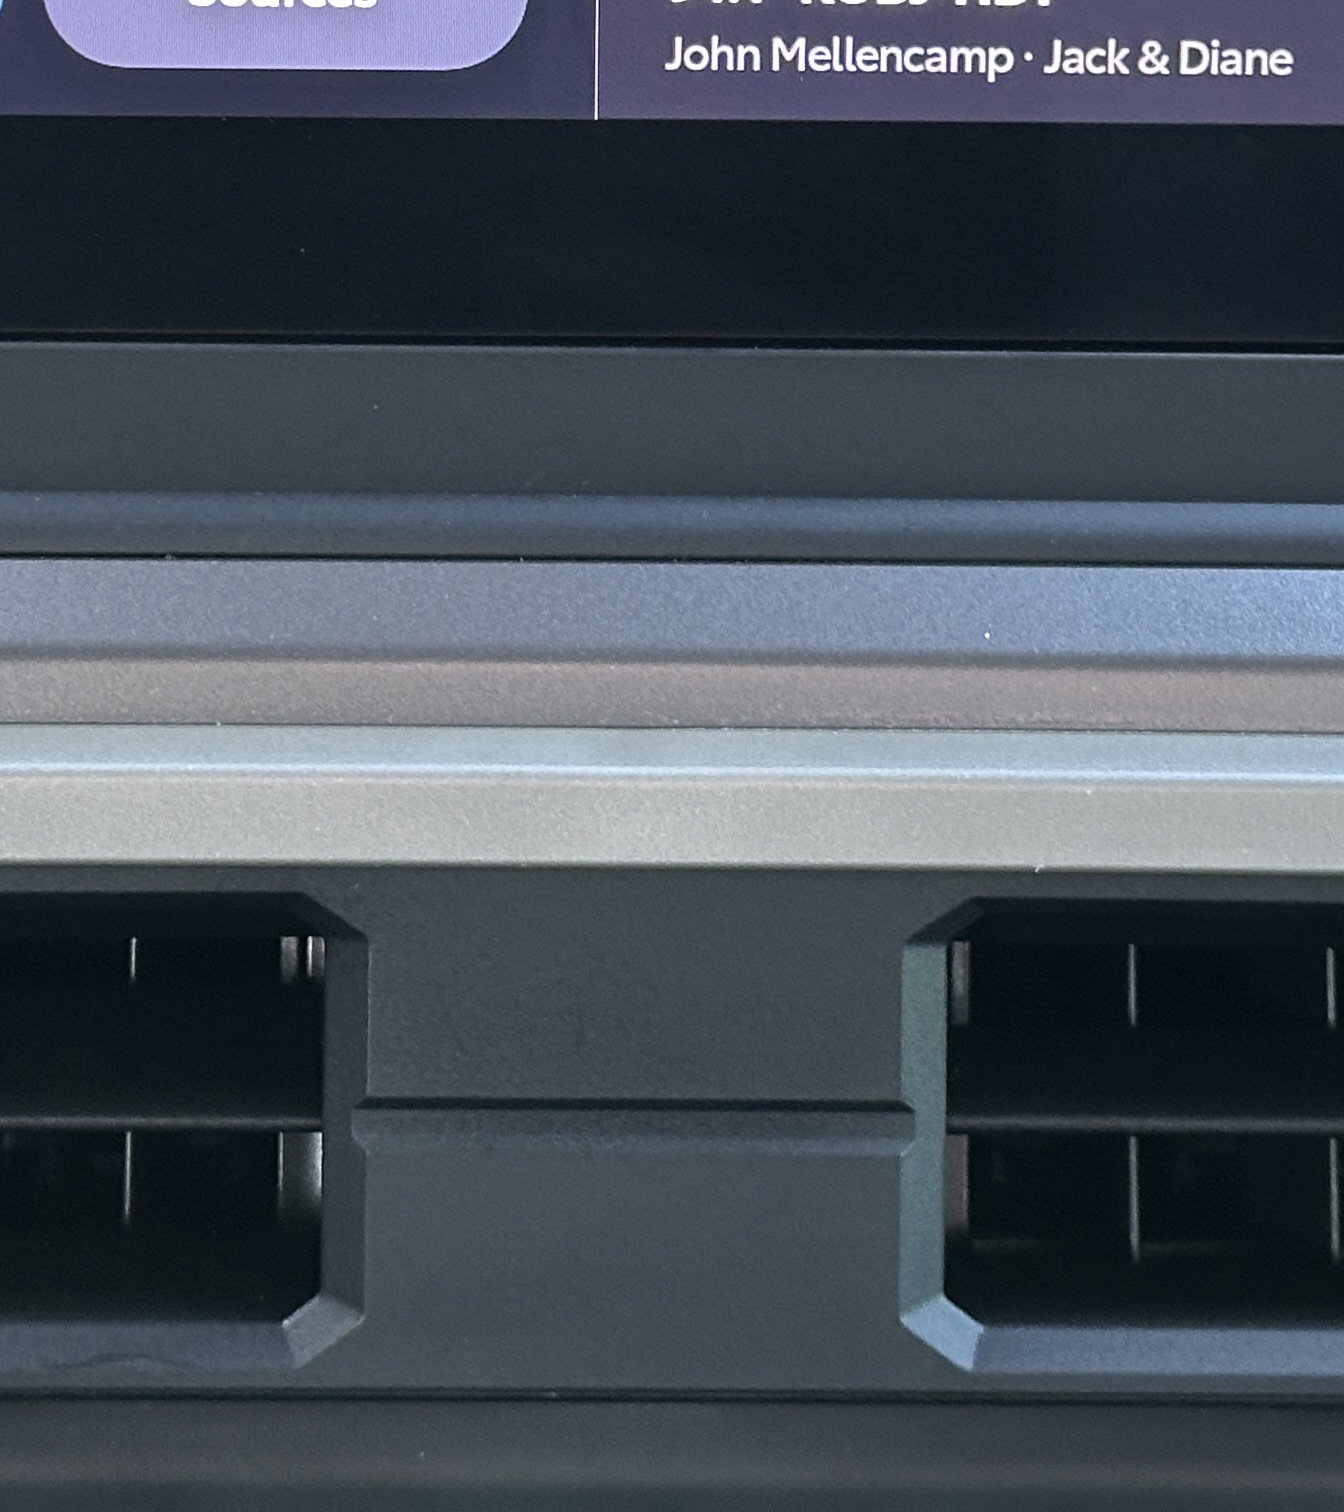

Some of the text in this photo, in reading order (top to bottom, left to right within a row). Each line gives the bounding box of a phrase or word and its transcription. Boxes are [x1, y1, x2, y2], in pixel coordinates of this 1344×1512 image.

[664, 34, 1294, 83] John Mellencamp Jack & Diane
